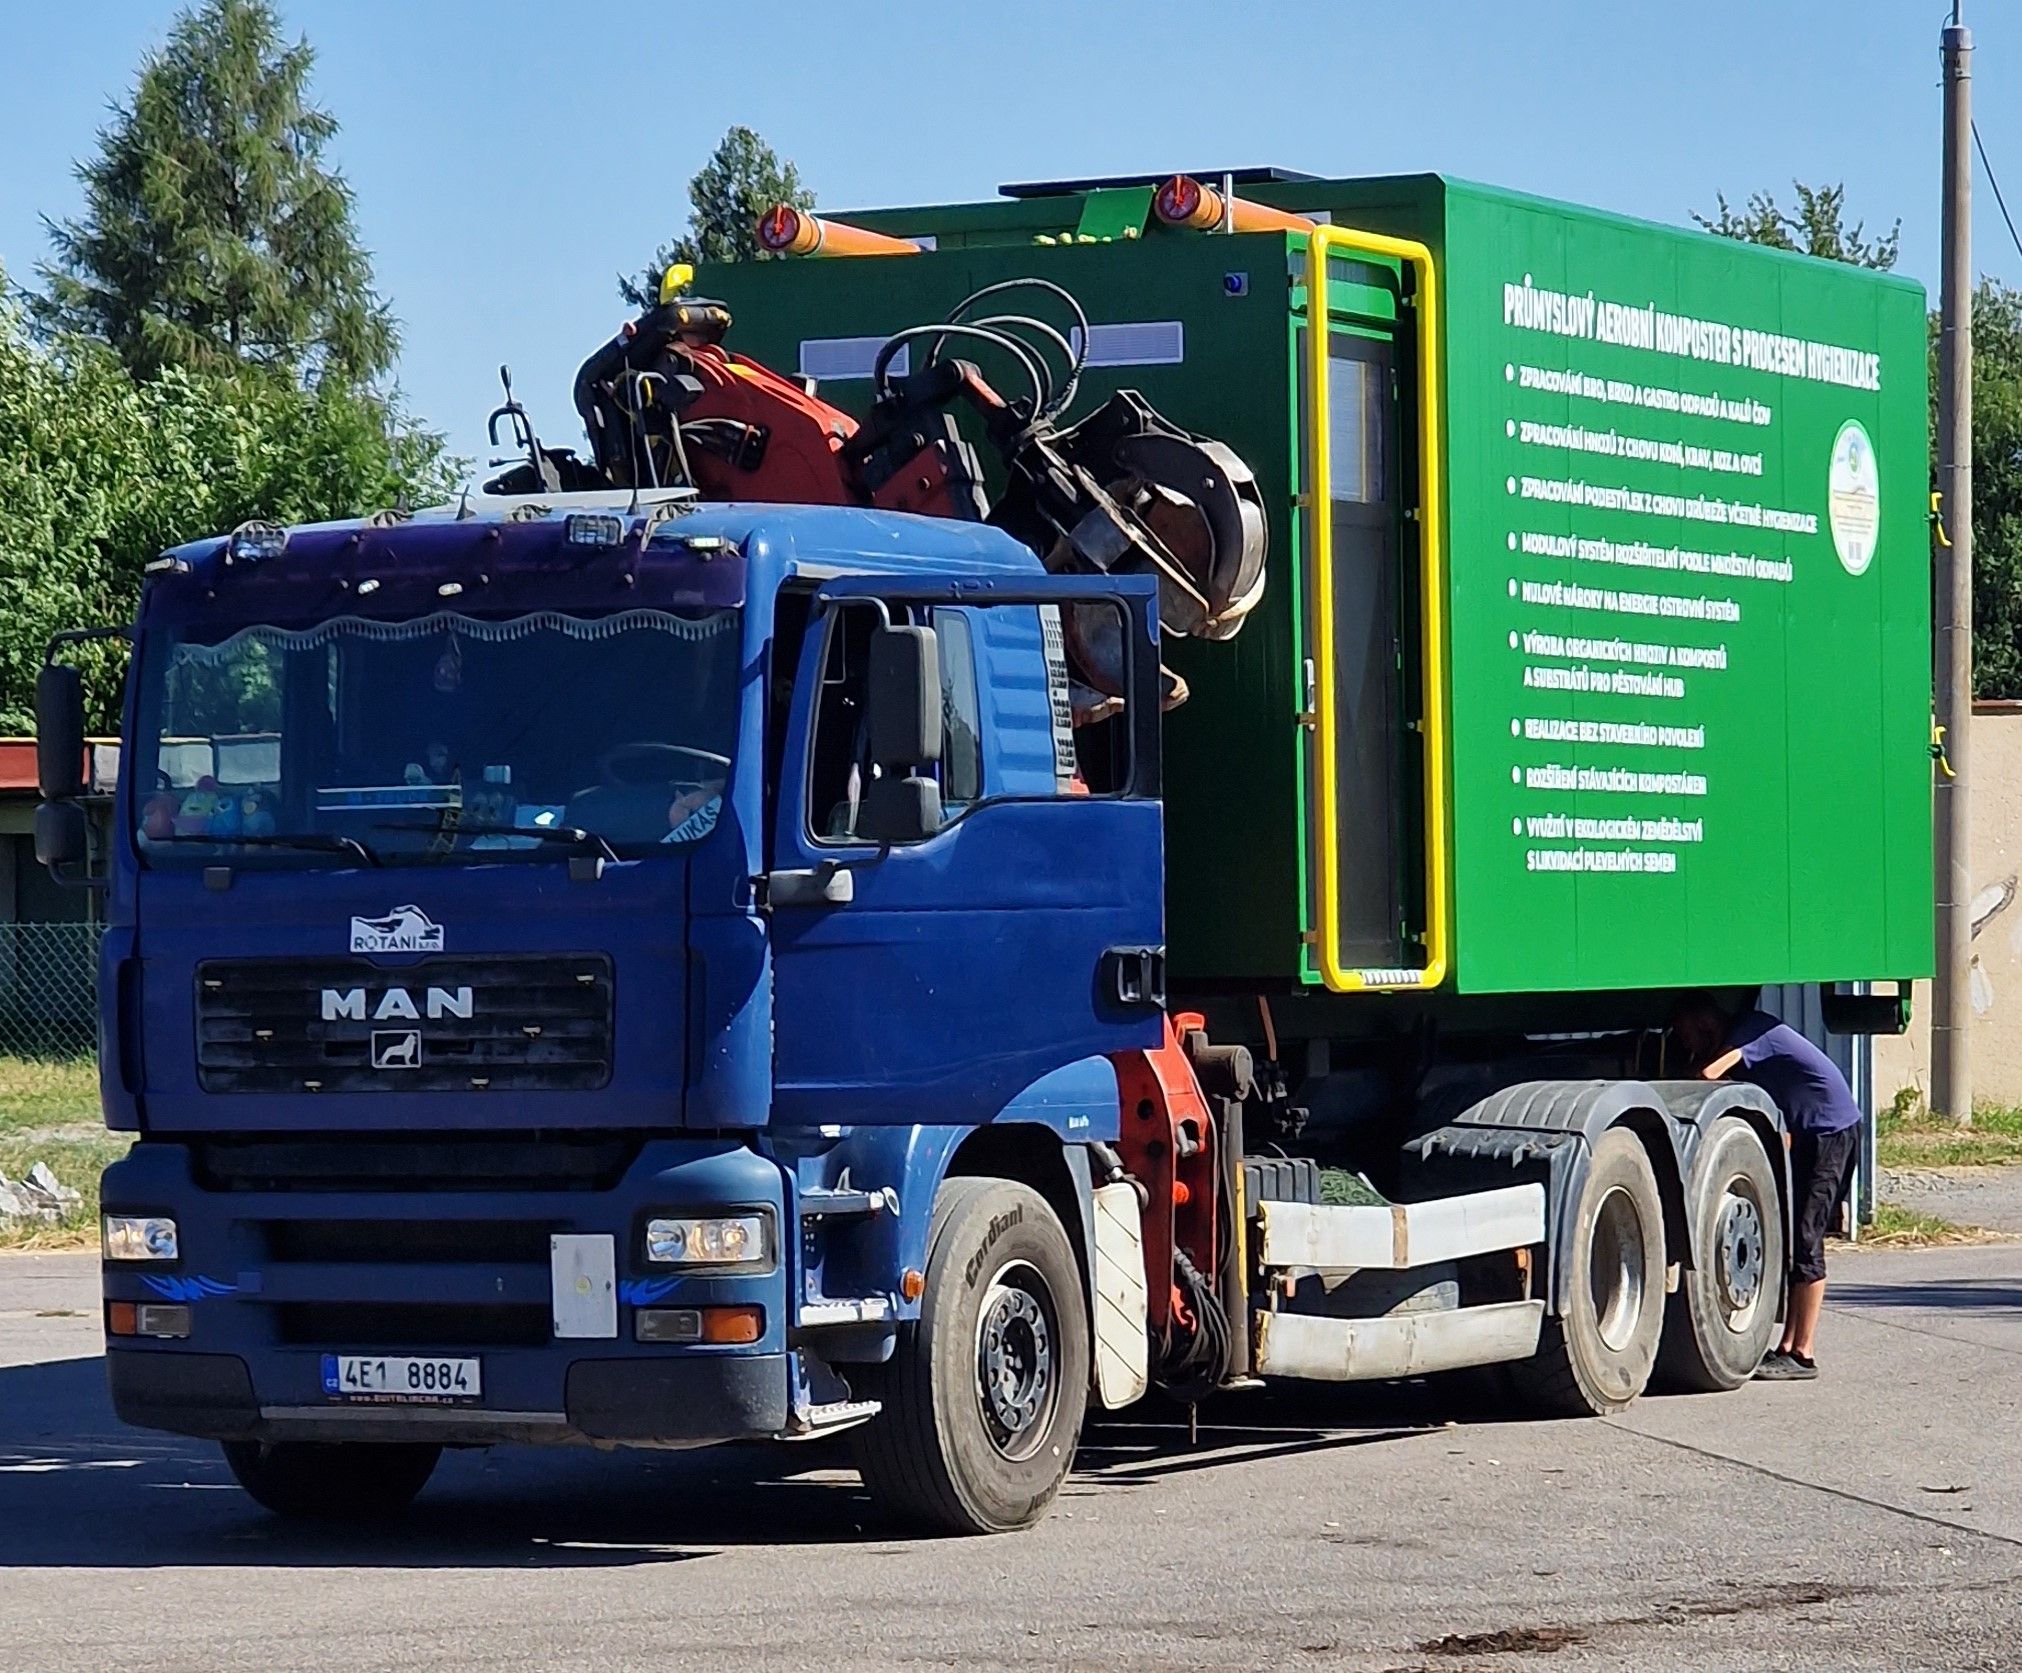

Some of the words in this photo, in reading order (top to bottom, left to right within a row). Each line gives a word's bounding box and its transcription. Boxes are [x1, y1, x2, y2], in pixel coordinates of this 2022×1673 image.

[1504, 272, 1595, 339] PRŮMYSLOVÝ
[1597, 301, 1654, 350] AEROBNÍ
[1656, 312, 1731, 364] KOMPOSTER
[1732, 327, 1741, 365] S
[1743, 329, 1806, 378] PROCESEM
[1807, 341, 1880, 391] HYGIENIZACE
[1519, 364, 1583, 395] ZPRACOVÁNÍ
[1635, 385, 1643, 405] A
[1644, 388, 1679, 411] GASTRO
[1681, 391, 1719, 418] ODPADŮ
[1720, 400, 1728, 418] A
[1729, 397, 1751, 423] KALŮ
[1752, 400, 1771, 426] ČOV
[1520, 421, 1583, 450] ZPRACOVÁNÍ
[1584, 428, 1617, 455] HNOJŮ
[1618, 436, 1625, 455] Z
[1626, 437, 1659, 461] CHOVU
[1713, 451, 1732, 471] KOZ
[1733, 453, 1740, 472] A
[1741, 453, 1762, 475] OVCÍ
[1520, 477, 1583, 504] ZPRACOVÁNÍ
[1584, 486, 1644, 511] PODESTÝLEK
[1645, 494, 1652, 513] Z
[1653, 495, 1684, 518] CHOVU
[1685, 493, 1727, 523] DRŮBEŽE
[1728, 501, 1762, 527] VČETNĚ
[1763, 509, 1818, 534] HYGIENIZACE
[1522, 532, 1577, 558] MODULOVÝ
[1680, 551, 1710, 573] PODLE
[1711, 552, 1755, 577] MNOŽSTVÍ
[1756, 557, 1793, 582] ODPADŮ
[1522, 580, 1562, 605] NULOVÉ
[1563, 583, 1603, 609] NÁROKY
[1604, 591, 1618, 611] NA
[1619, 592, 1659, 615] ENERGIE
[1660, 596, 1705, 620] OSTROVNÍ
[1706, 598, 1740, 622] SYSTÉM
[1522, 630, 1563, 656] VÝROBA
[1565, 637, 1632, 661] ORGANICKÝCH
[1668, 647, 1677, 666] A
[1677, 644, 1727, 669] KOMPOSTŮ
[1523, 666, 1532, 687] A
[1533, 664, 1589, 691] SUBSTRÁTŮ
[1590, 672, 1610, 693] PRO
[1612, 669, 1663, 696] PĚSTOVÁNÍ
[1663, 677, 1685, 698] HUB
[1525, 718, 1579, 742] REALIZACE
[1580, 721, 1599, 743] BEZ
[1599, 722, 1657, 746] STAVEBNÍHO
[1658, 724, 1705, 748] POVOLENÍ
[1526, 764, 1577, 789] ROZŠÍŘENÍ
[1578, 766, 1638, 791] STÁVAJÍCÍCH
[1638, 770, 1707, 795] KOMPOSTÁREN
[1526, 813, 1566, 837] VYUŽITÍ
[1566, 818, 1574, 838] V
[1575, 815, 1641, 840] EKOLOGICKÉM
[1641, 816, 1703, 842] ZEMĚDĚLSTVÍ
[1527, 850, 1536, 871] S
[1536, 846, 1583, 871] LIKVIDACÍ
[1585, 847, 1643, 872] PLEVELNÝCH
[1644, 852, 1676, 872] SEMEN
[354, 935, 416, 950] ROTANI
[322, 986, 473, 1021] MAN
[345, 1361, 387, 1390] 4E1
[407, 1362, 467, 1391] 8884
